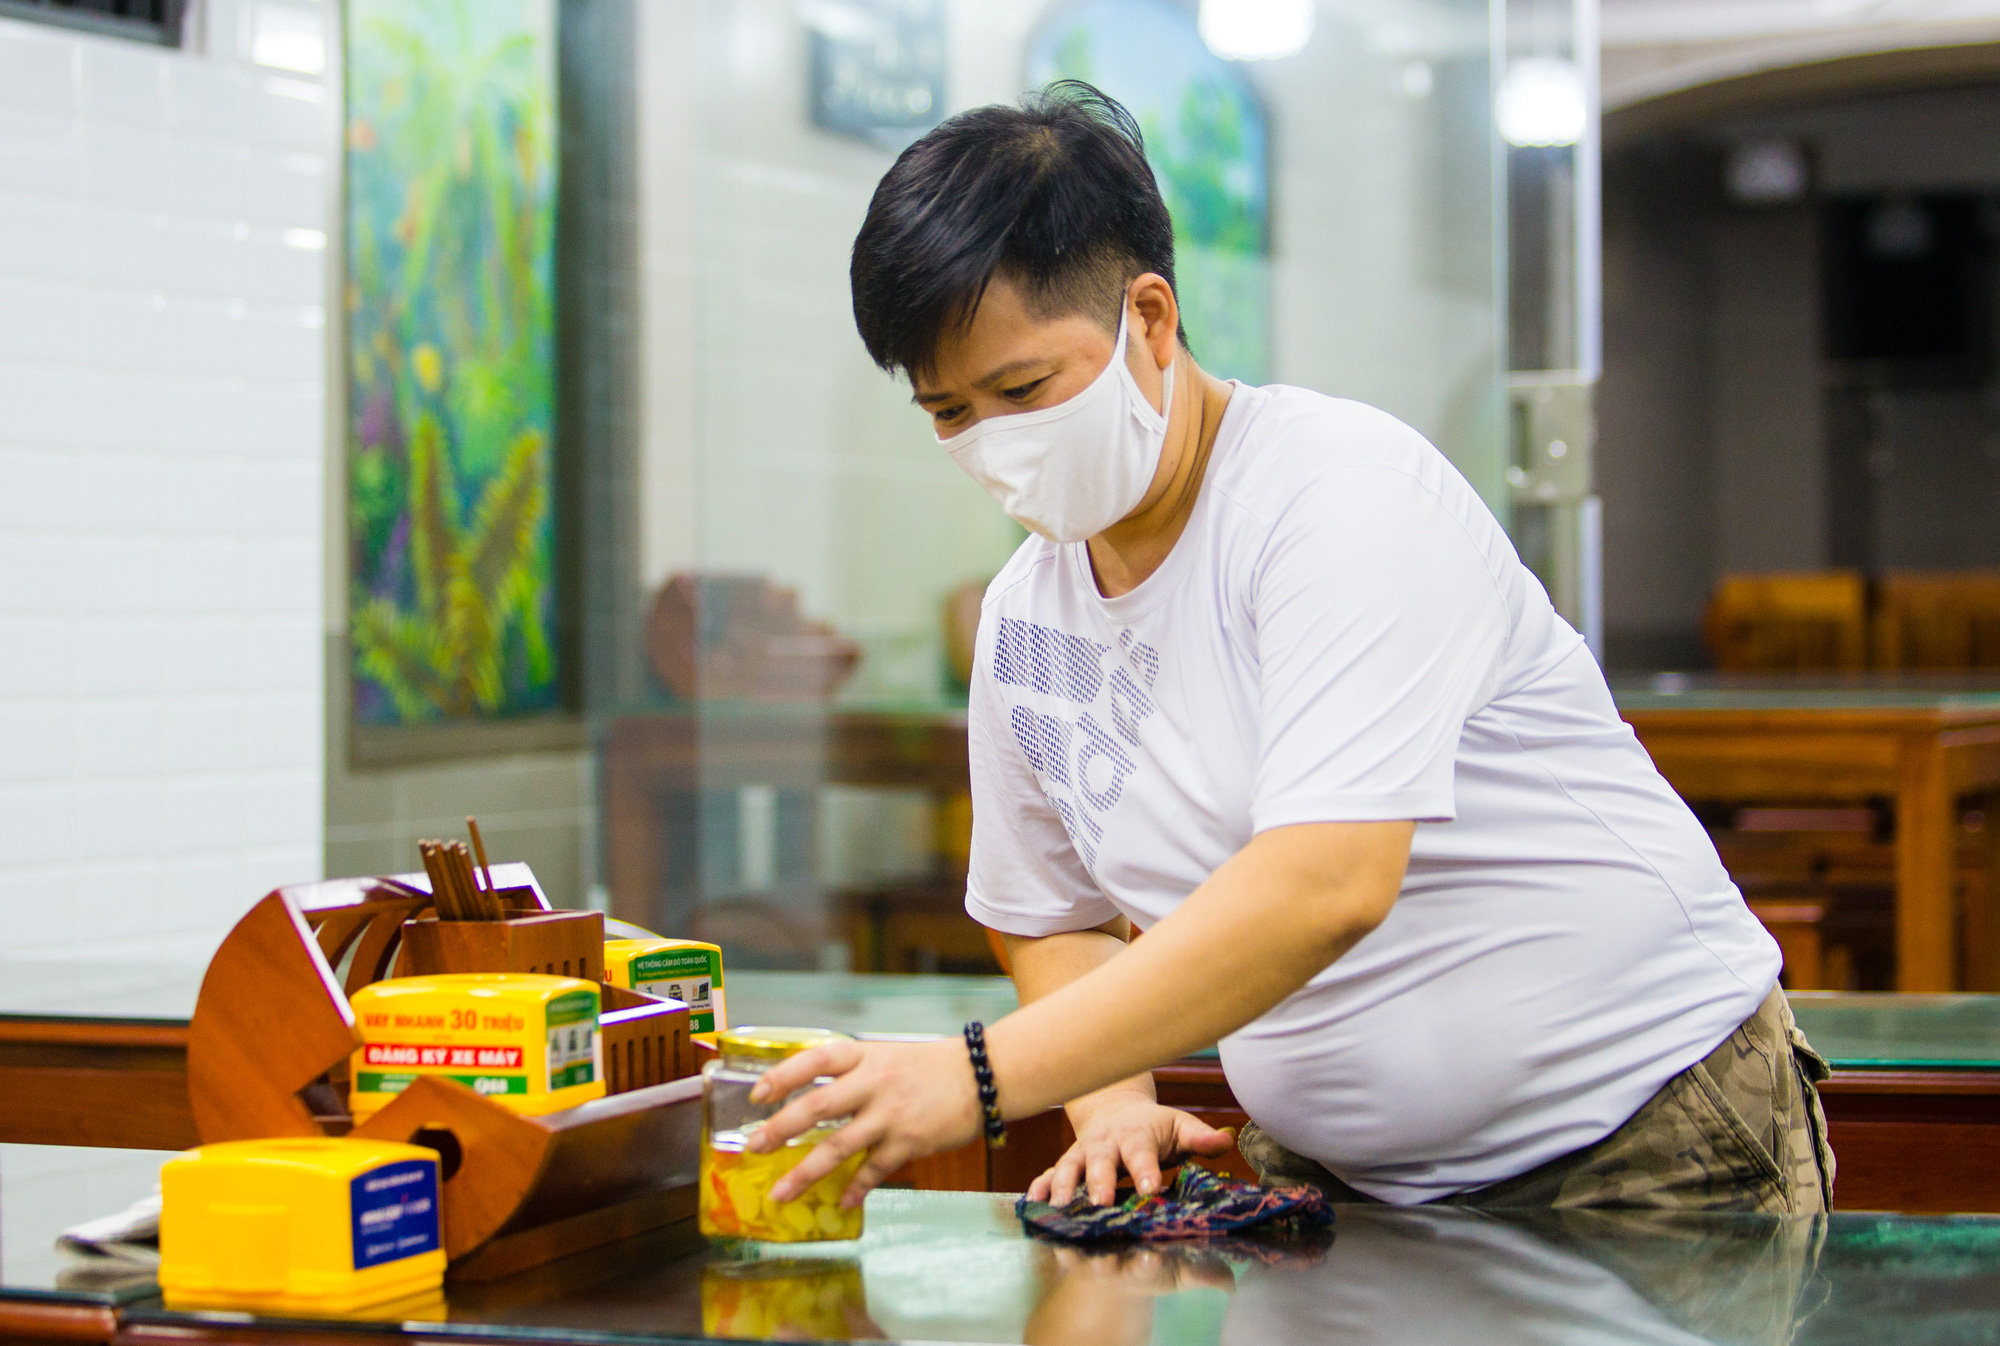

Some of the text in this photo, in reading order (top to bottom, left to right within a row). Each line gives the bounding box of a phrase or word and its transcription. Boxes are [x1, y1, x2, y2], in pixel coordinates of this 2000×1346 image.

[395, 1015, 444, 1027] NHANH
[451, 1010, 476, 1029] 30
[483, 1013, 524, 1031] TRIỆU
[452, 1050, 476, 1065] XE
[477, 1048, 519, 1066] MÁY
